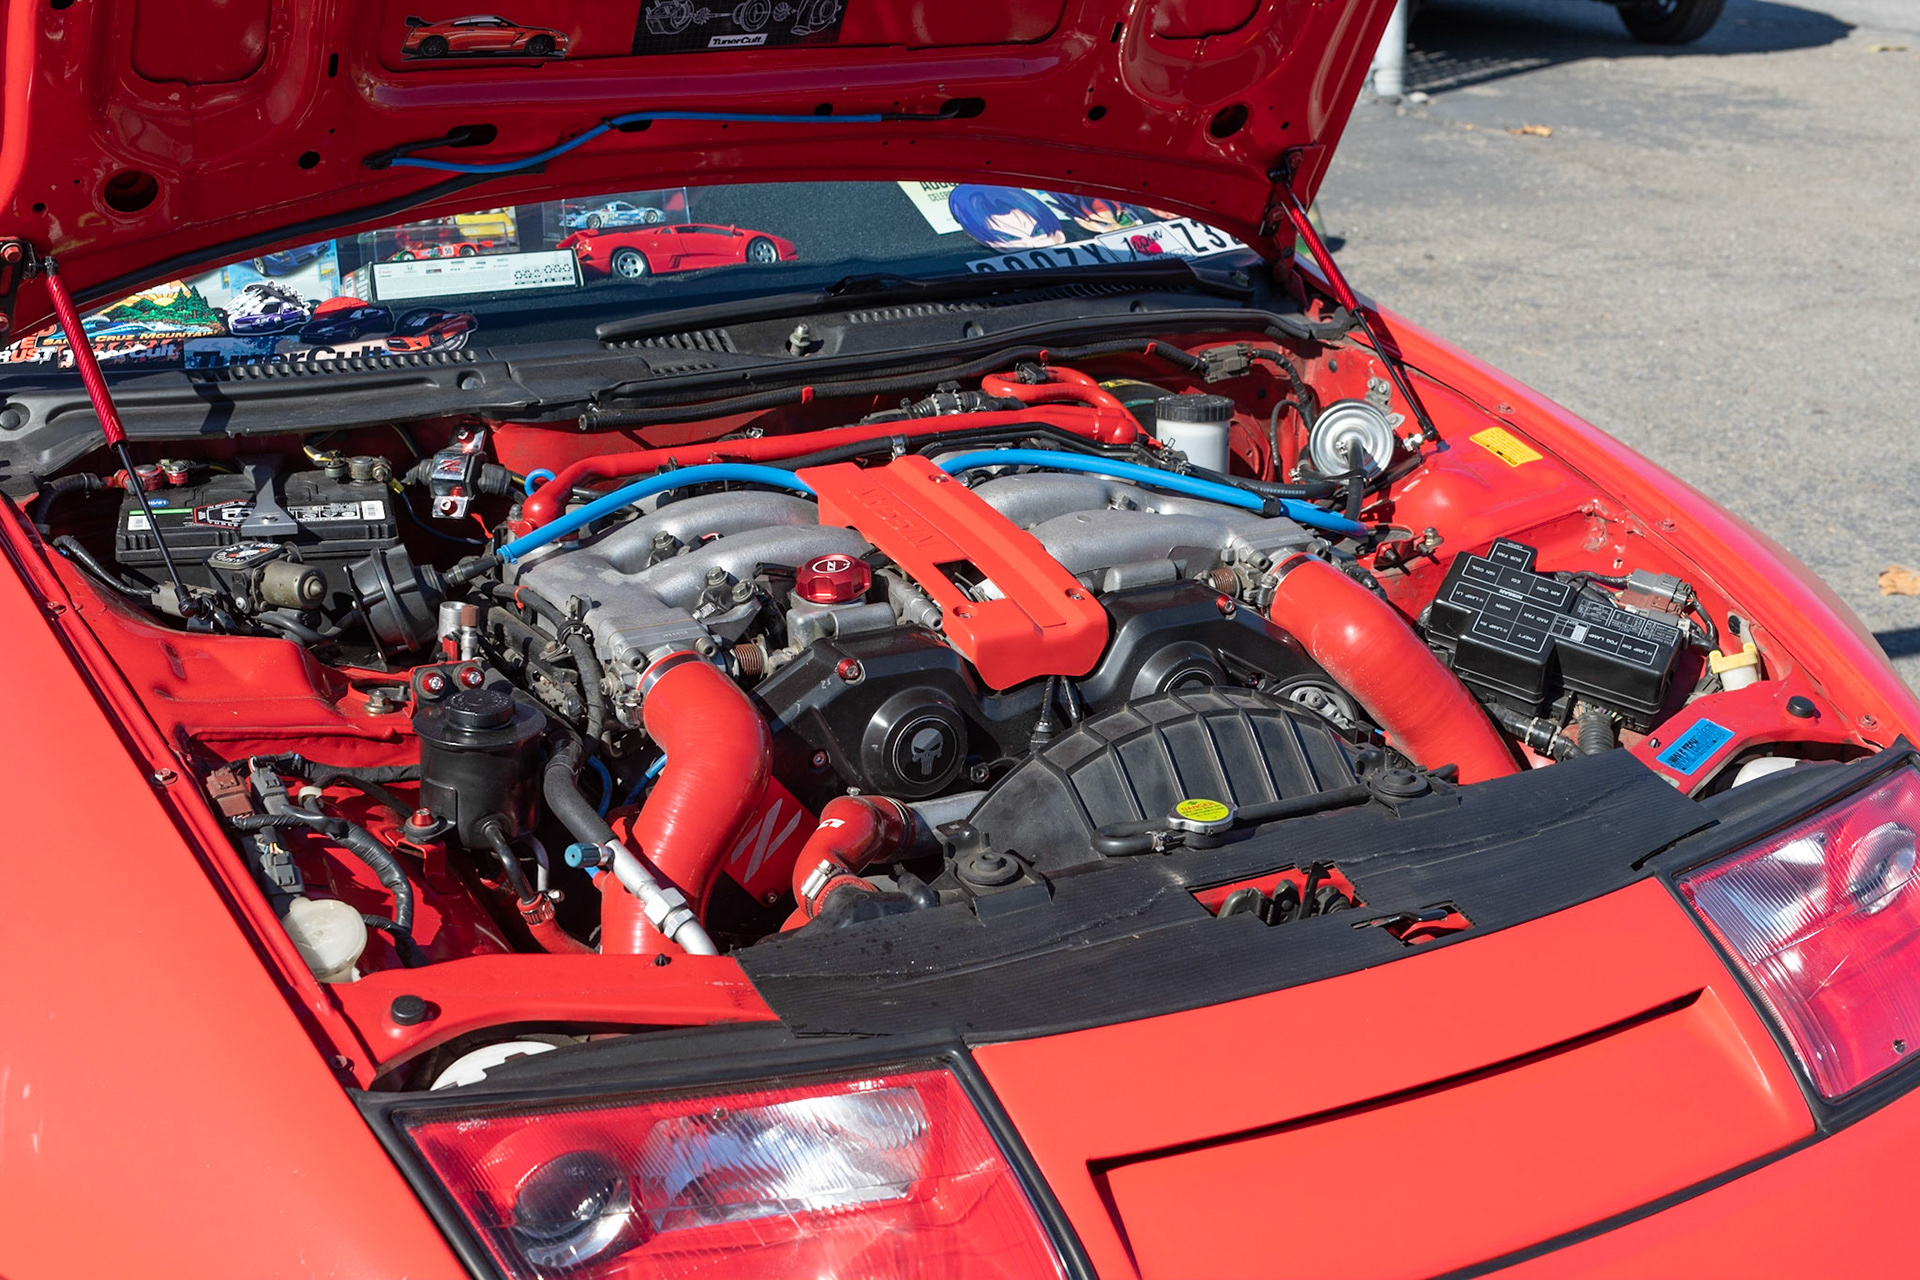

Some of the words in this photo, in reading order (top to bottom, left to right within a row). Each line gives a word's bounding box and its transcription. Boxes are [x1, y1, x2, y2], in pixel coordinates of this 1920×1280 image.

[1170, 220, 1241, 253] Z3
[1122, 228, 1163, 261] Japan
[95, 334, 135, 342] CRUZ
[1496, 551, 1508, 559] FAN
[1510, 555, 1522, 563] SUB
[1472, 565, 1484, 573] COIL
[1499, 589, 1523, 600] NISSAN
[1495, 603, 1511, 611] HORN
[1523, 612, 1535, 620] FAN
[1517, 633, 1536, 643] THEFT
[1588, 633, 1604, 642] LAMP
